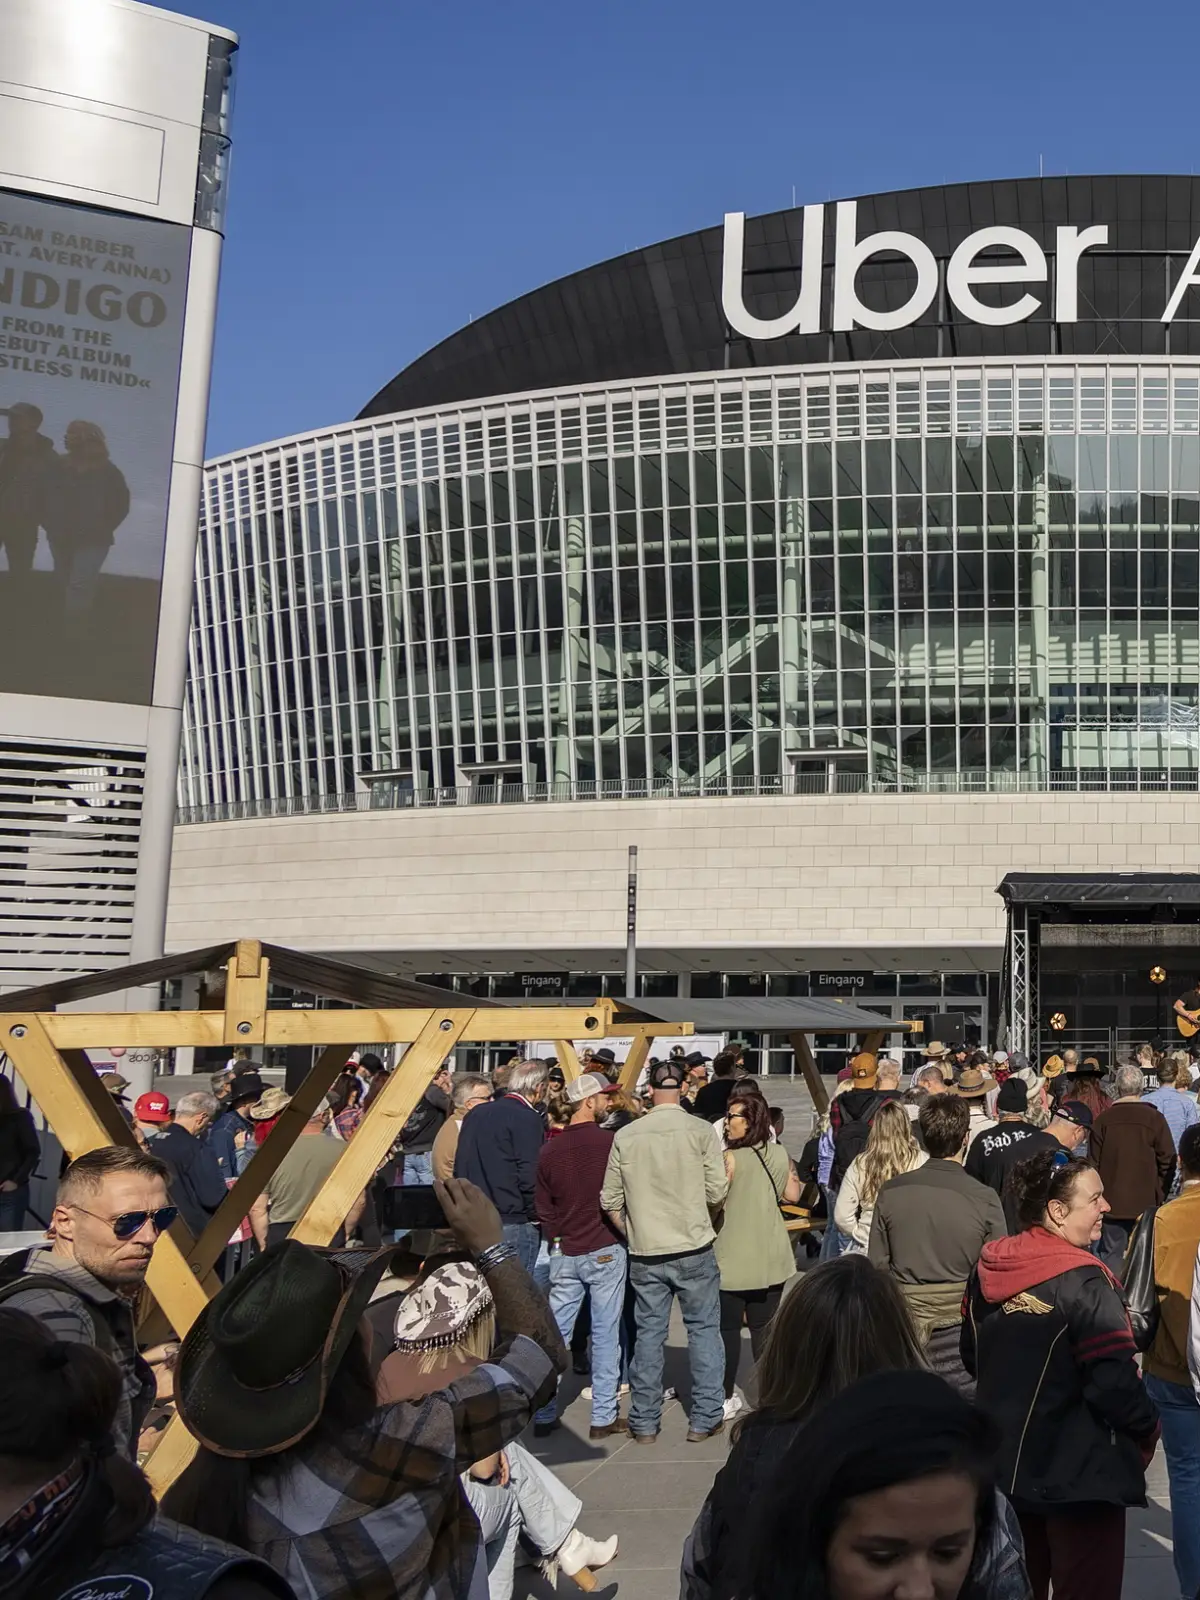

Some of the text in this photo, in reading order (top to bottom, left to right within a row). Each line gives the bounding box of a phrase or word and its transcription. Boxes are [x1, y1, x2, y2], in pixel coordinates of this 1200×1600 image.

[51, 230, 136, 260] BARBER
[28, 246, 97, 270] AVERY
[102, 260, 172, 285] ANNA)
[722, 200, 1108, 340] Uber
[2, 316, 112, 347] FROM THE
[56, 344, 131, 368] ALBUM
[80, 366, 151, 389] MIND«
[521, 975, 561, 988] Eingang
[818, 974, 864, 988] Eingang
